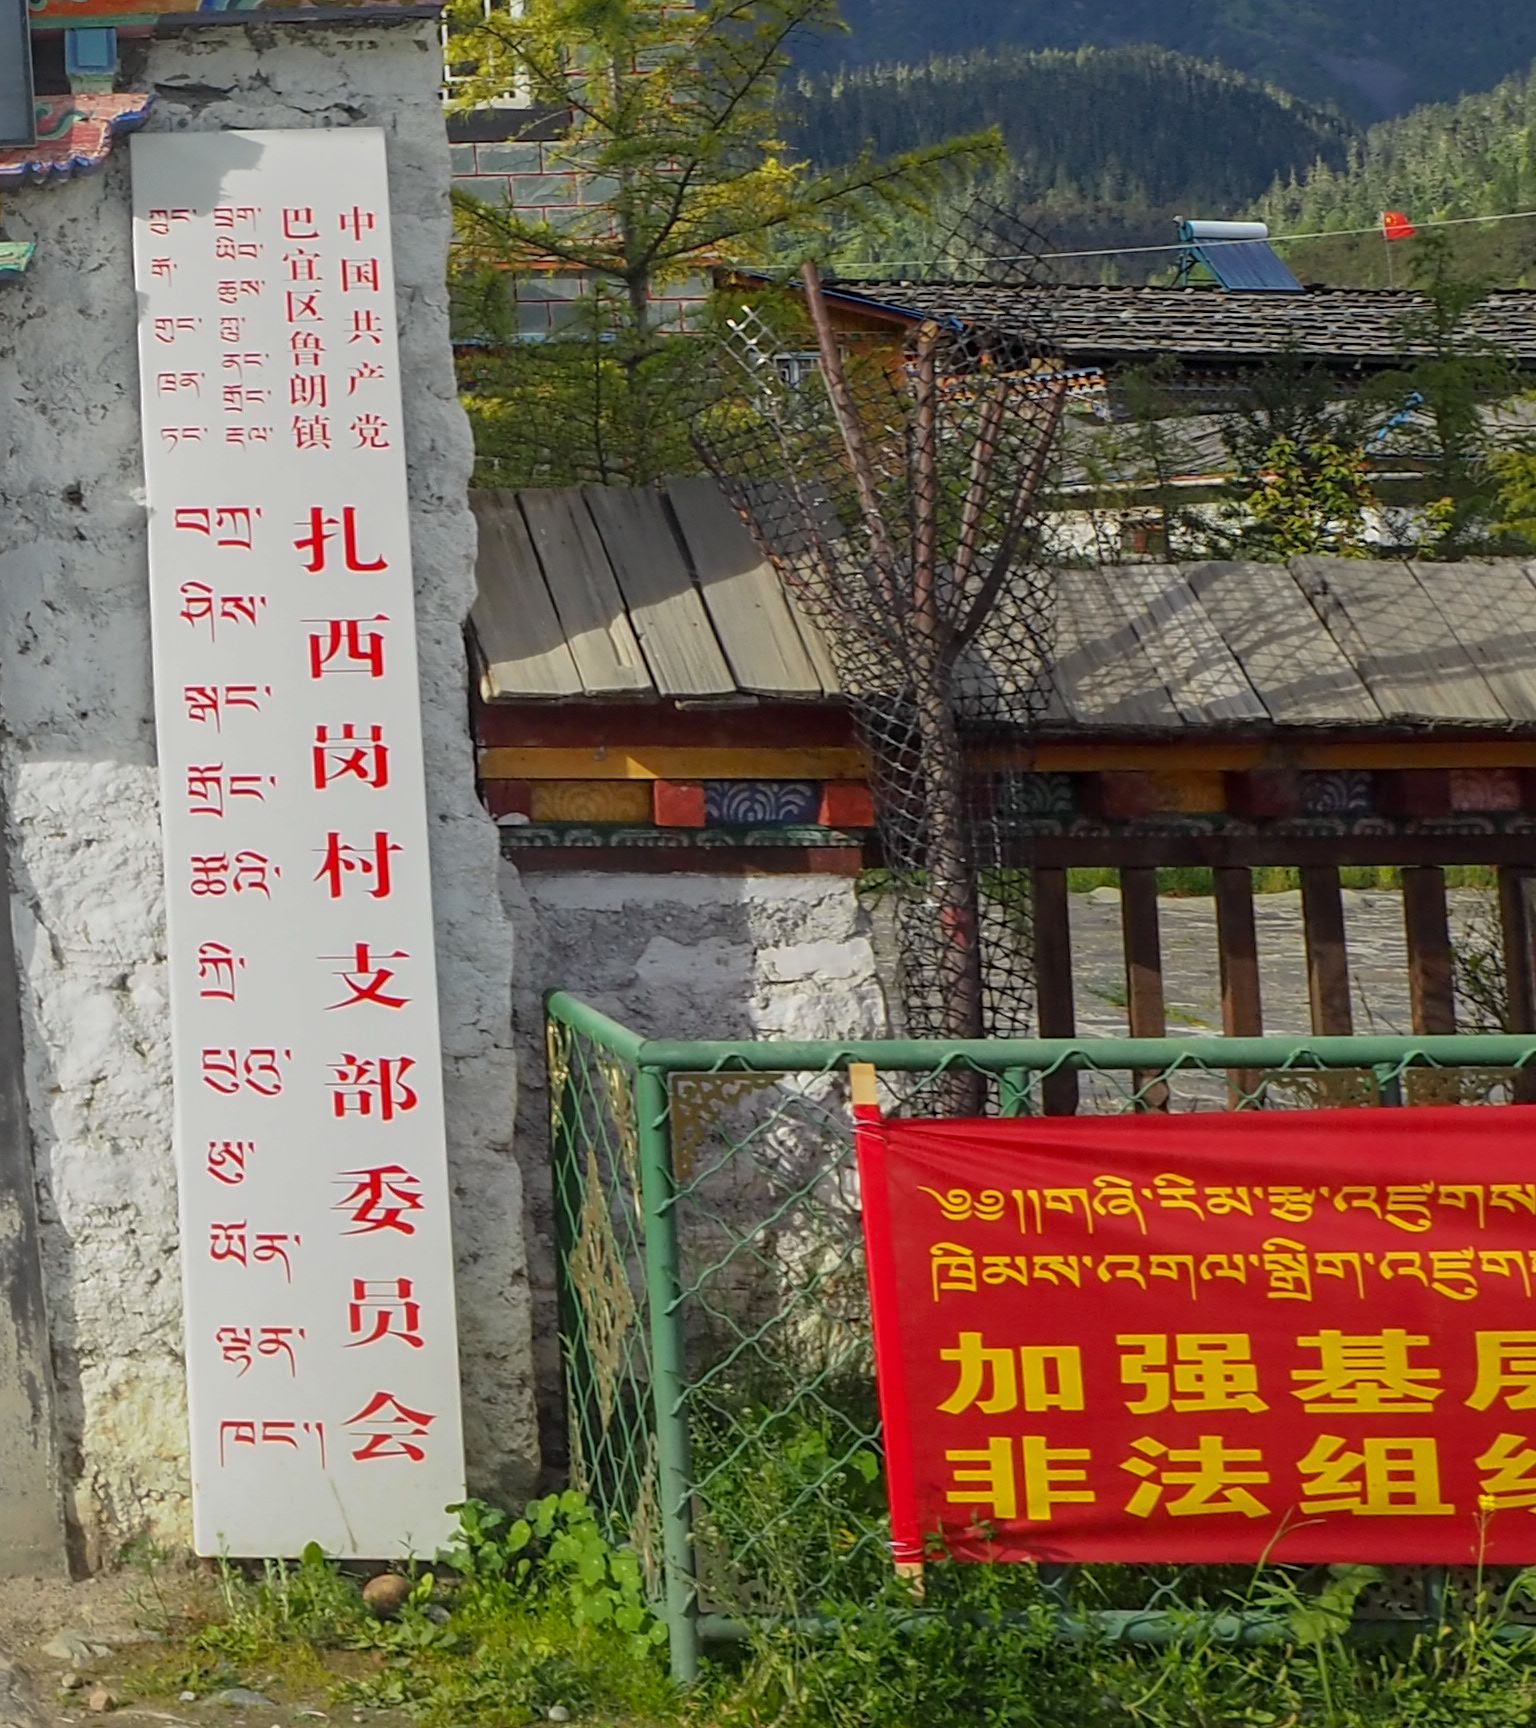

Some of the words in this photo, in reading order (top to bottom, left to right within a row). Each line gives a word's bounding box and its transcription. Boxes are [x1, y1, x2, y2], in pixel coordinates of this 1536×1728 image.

[281, 206, 331, 450] 巴宜区鲁朗镇
[339, 205, 390, 450] 中国共产党
[293, 506, 438, 1462] 扎西岗村支部委员会
[929, 1237, 1536, 1302] ཁྲིམས་འགལ་སྒྲིག་འཛུག
